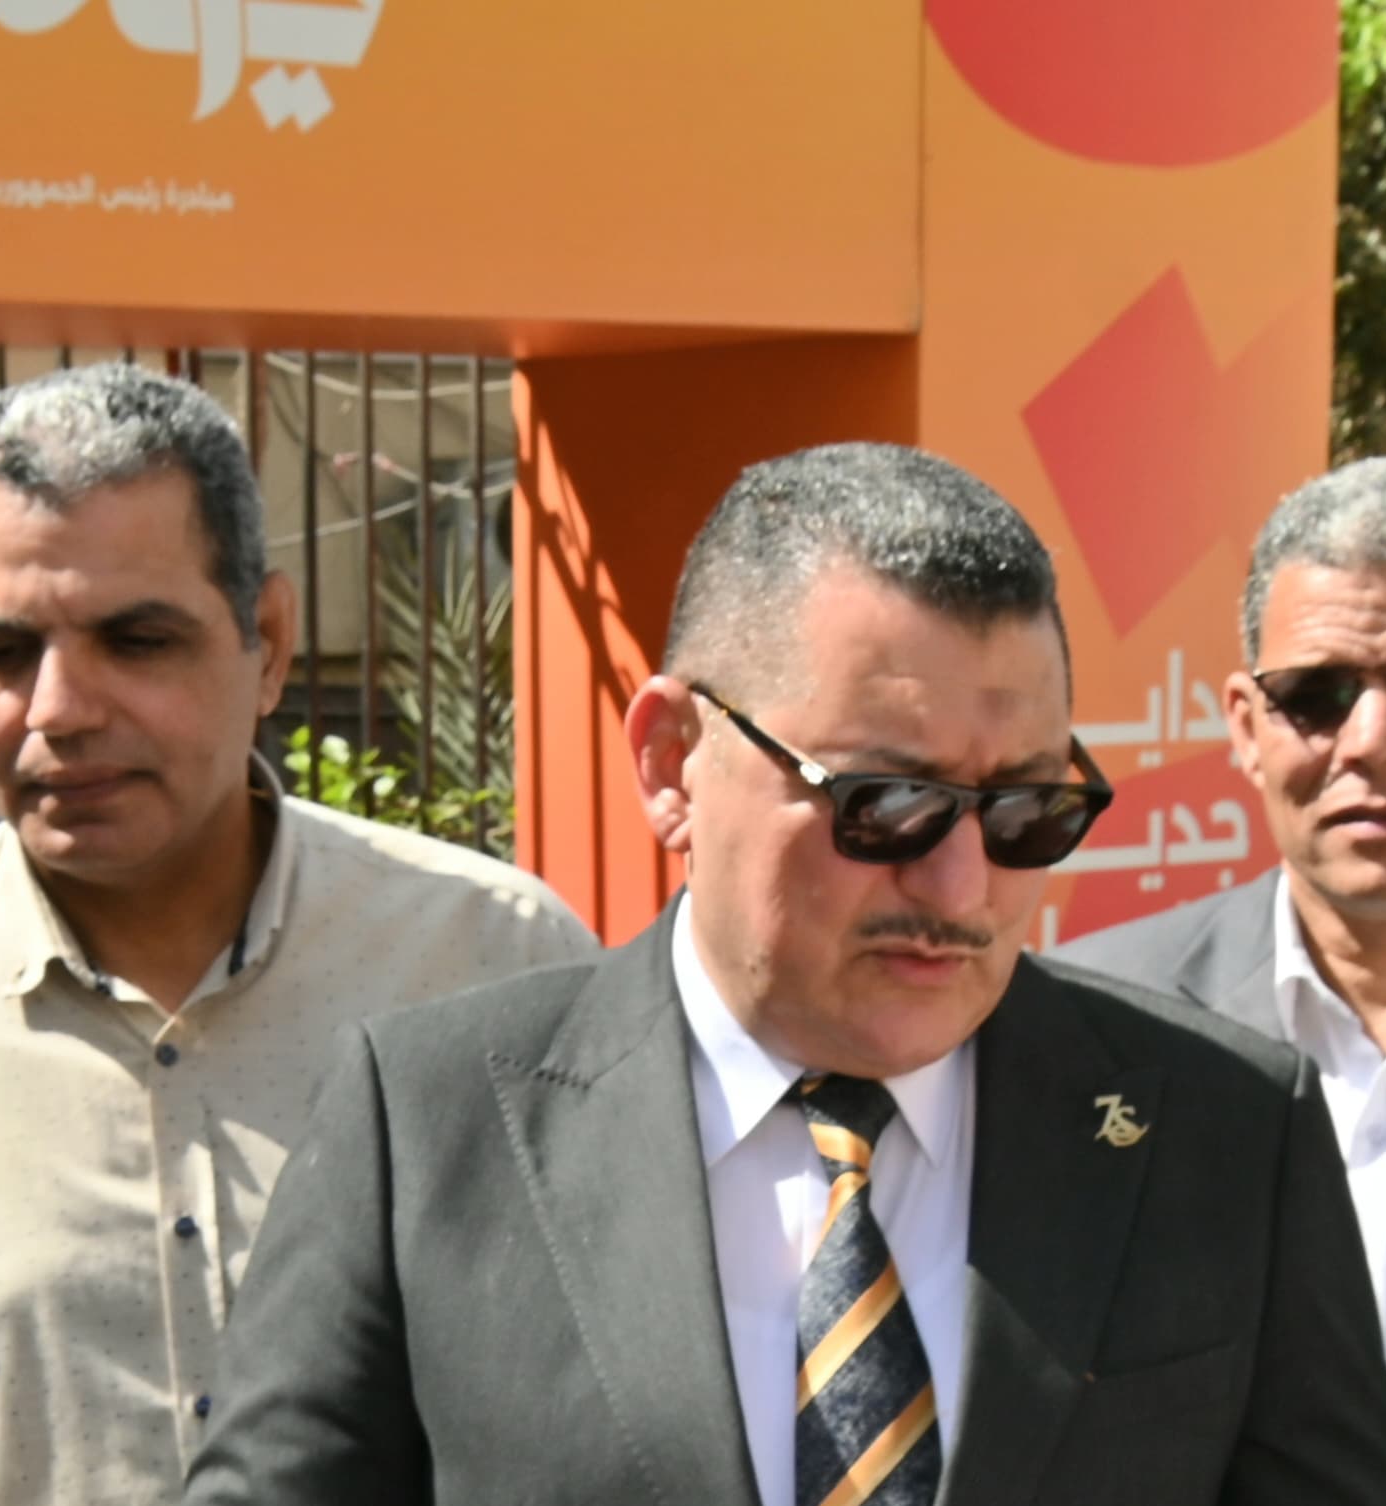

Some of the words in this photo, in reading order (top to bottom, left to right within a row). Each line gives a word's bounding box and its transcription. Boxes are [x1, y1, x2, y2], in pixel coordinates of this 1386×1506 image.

[100, 175, 162, 213] رئيس
[165, 180, 234, 214] مبادرة
[1050, 798, 1249, 891] جدي
